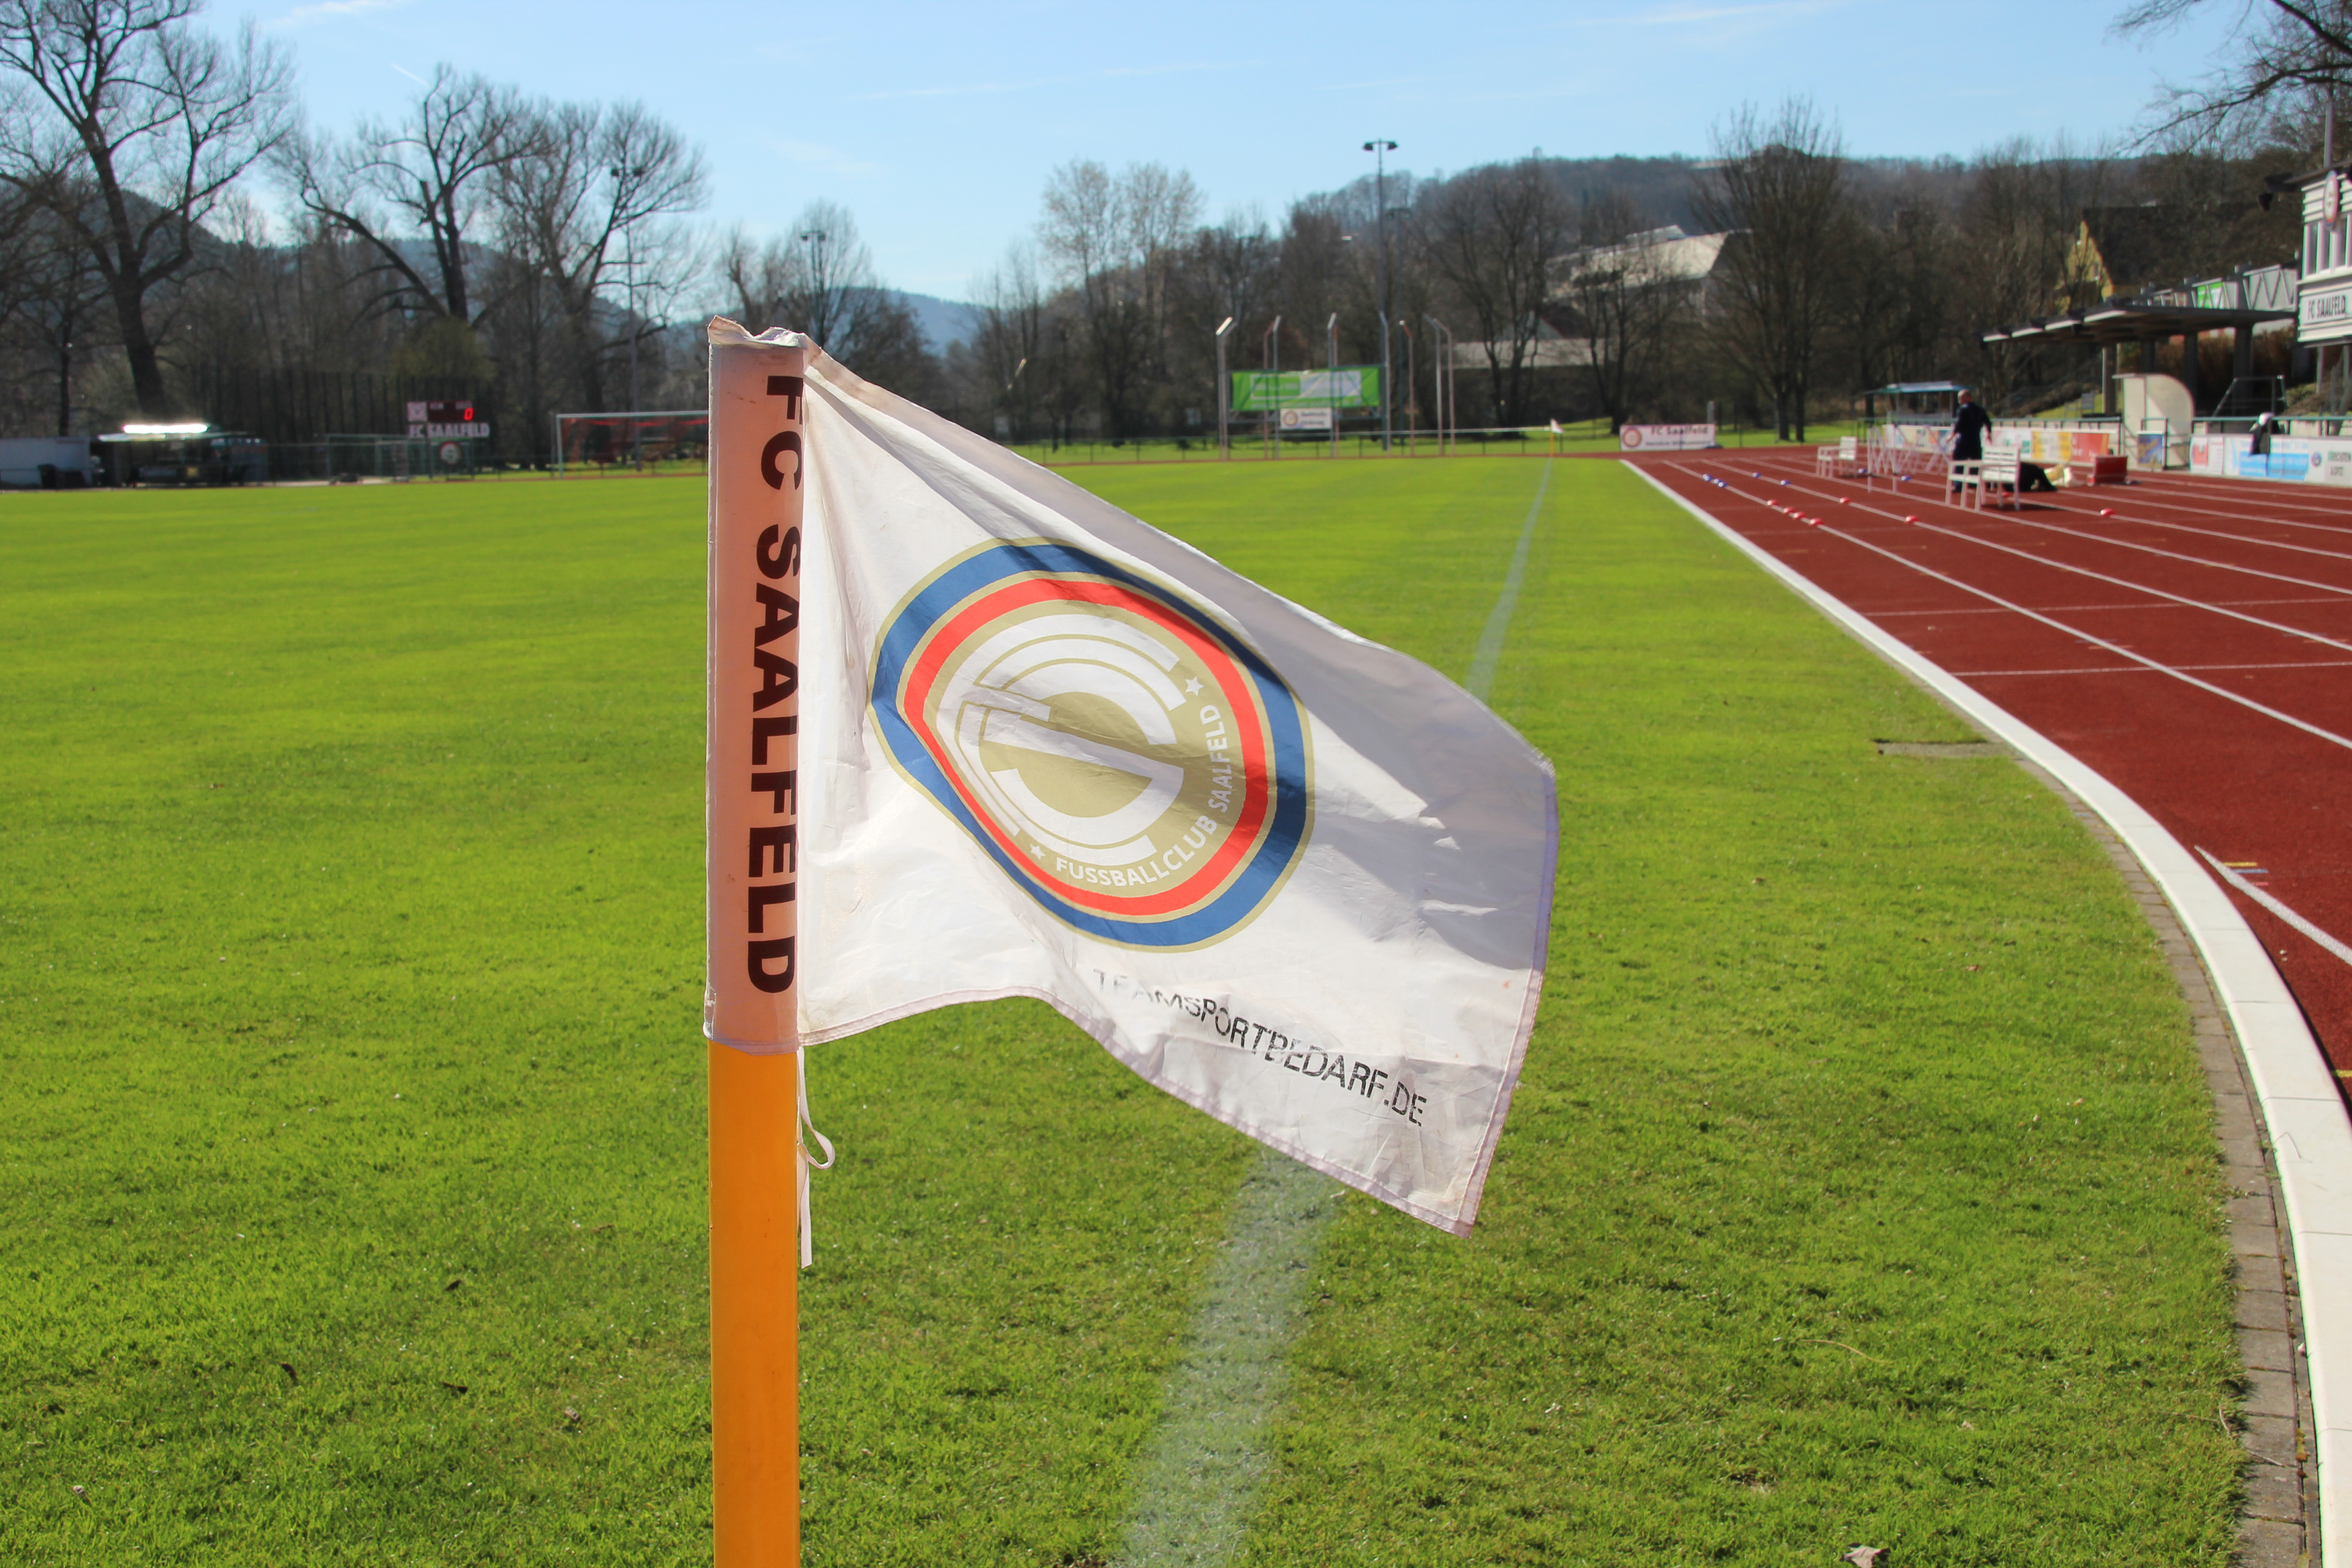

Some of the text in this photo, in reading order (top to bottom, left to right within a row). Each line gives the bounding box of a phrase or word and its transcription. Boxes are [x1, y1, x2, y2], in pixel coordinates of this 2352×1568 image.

[2316, 295, 2346, 319] SAALFELD
[427, 423, 490, 438] SAALFELD
[748, 374, 804, 994] FC SAALFELD
[1055, 704, 1233, 886] FUSSBALLCLUB SAALFELD
[1092, 968, 1428, 1127] TEAMSPORTBEDARF.DE
